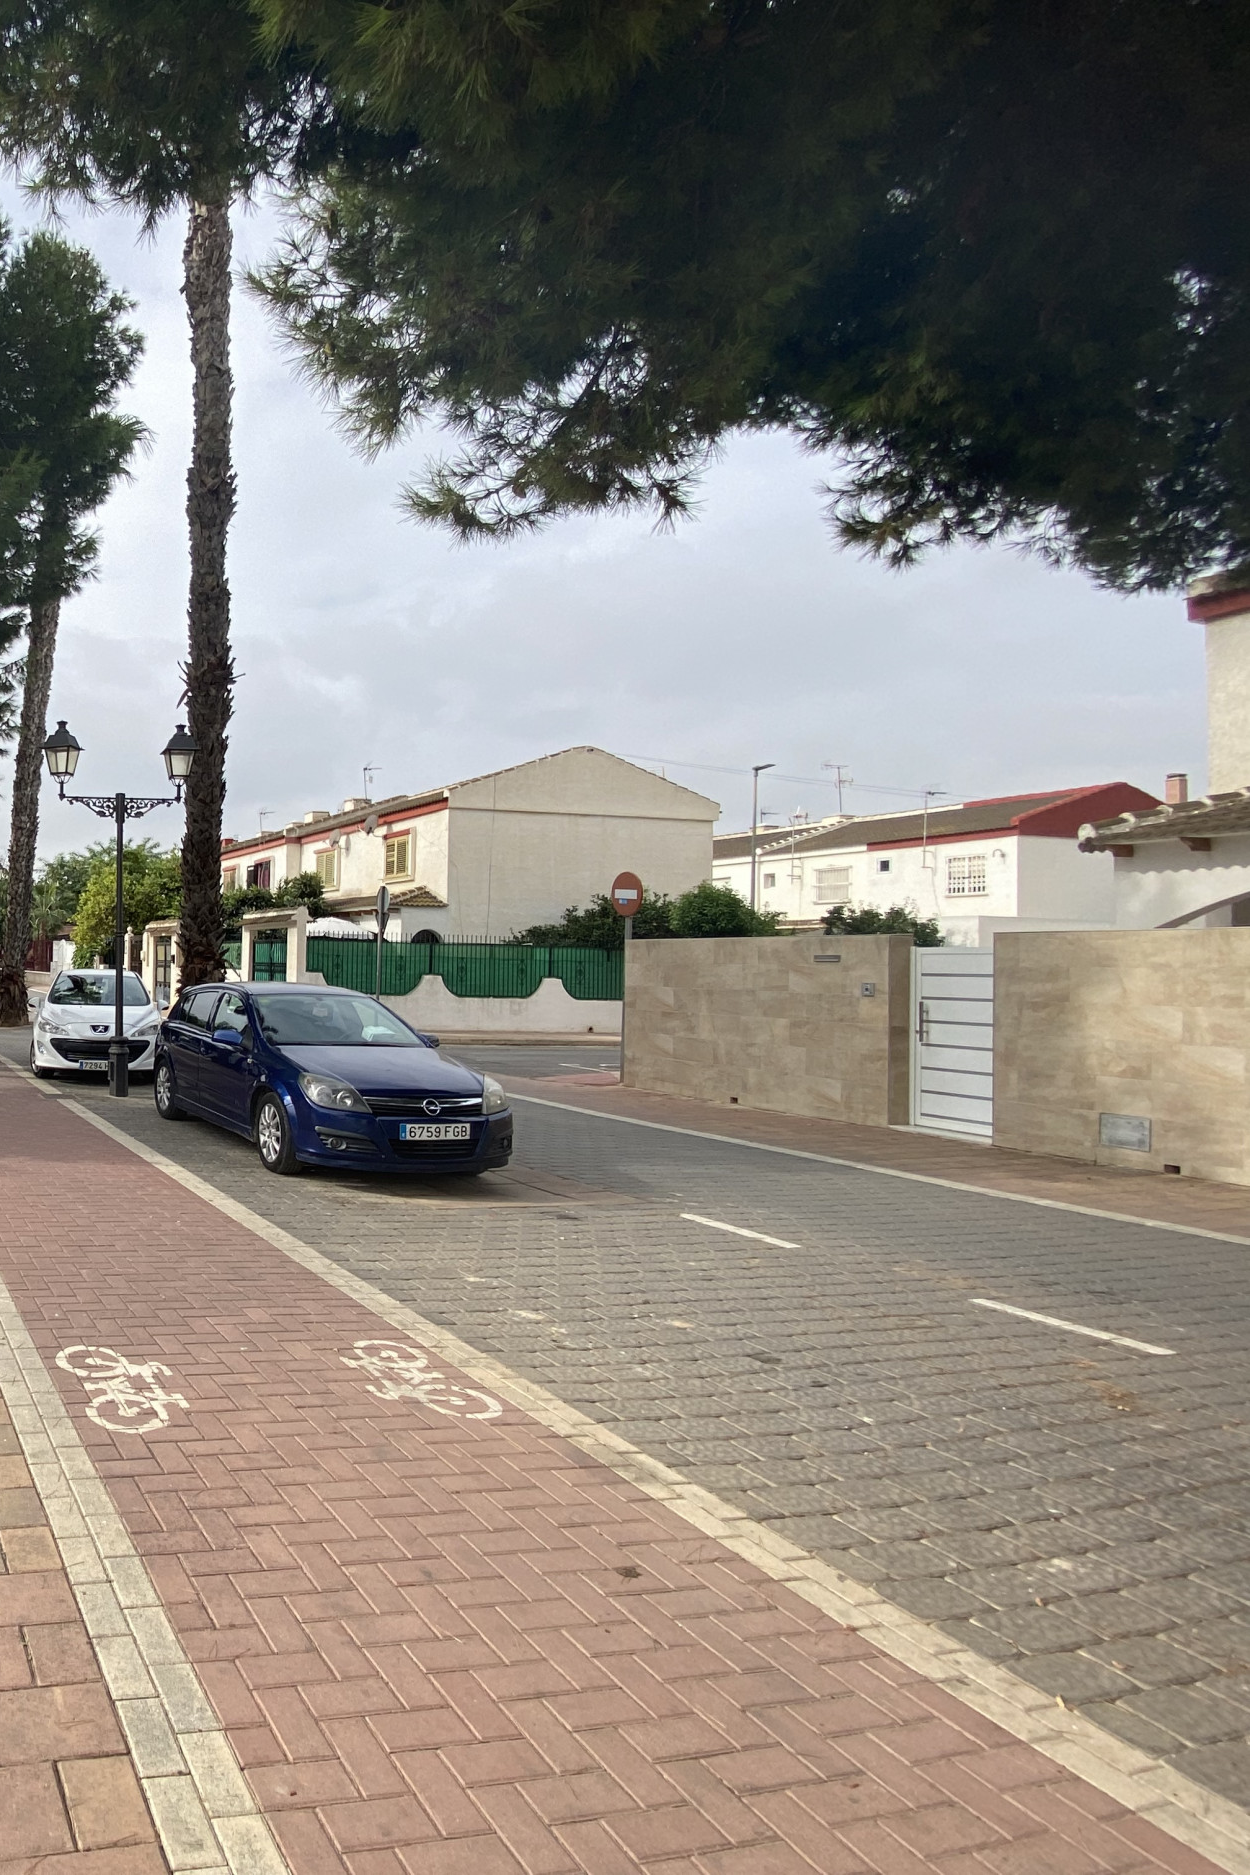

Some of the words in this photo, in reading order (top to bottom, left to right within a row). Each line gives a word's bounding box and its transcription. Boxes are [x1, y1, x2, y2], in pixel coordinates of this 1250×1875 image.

[84, 1062, 103, 1070] 7294
[409, 1126, 441, 1138] 6759
[444, 1125, 467, 1138] FGB
